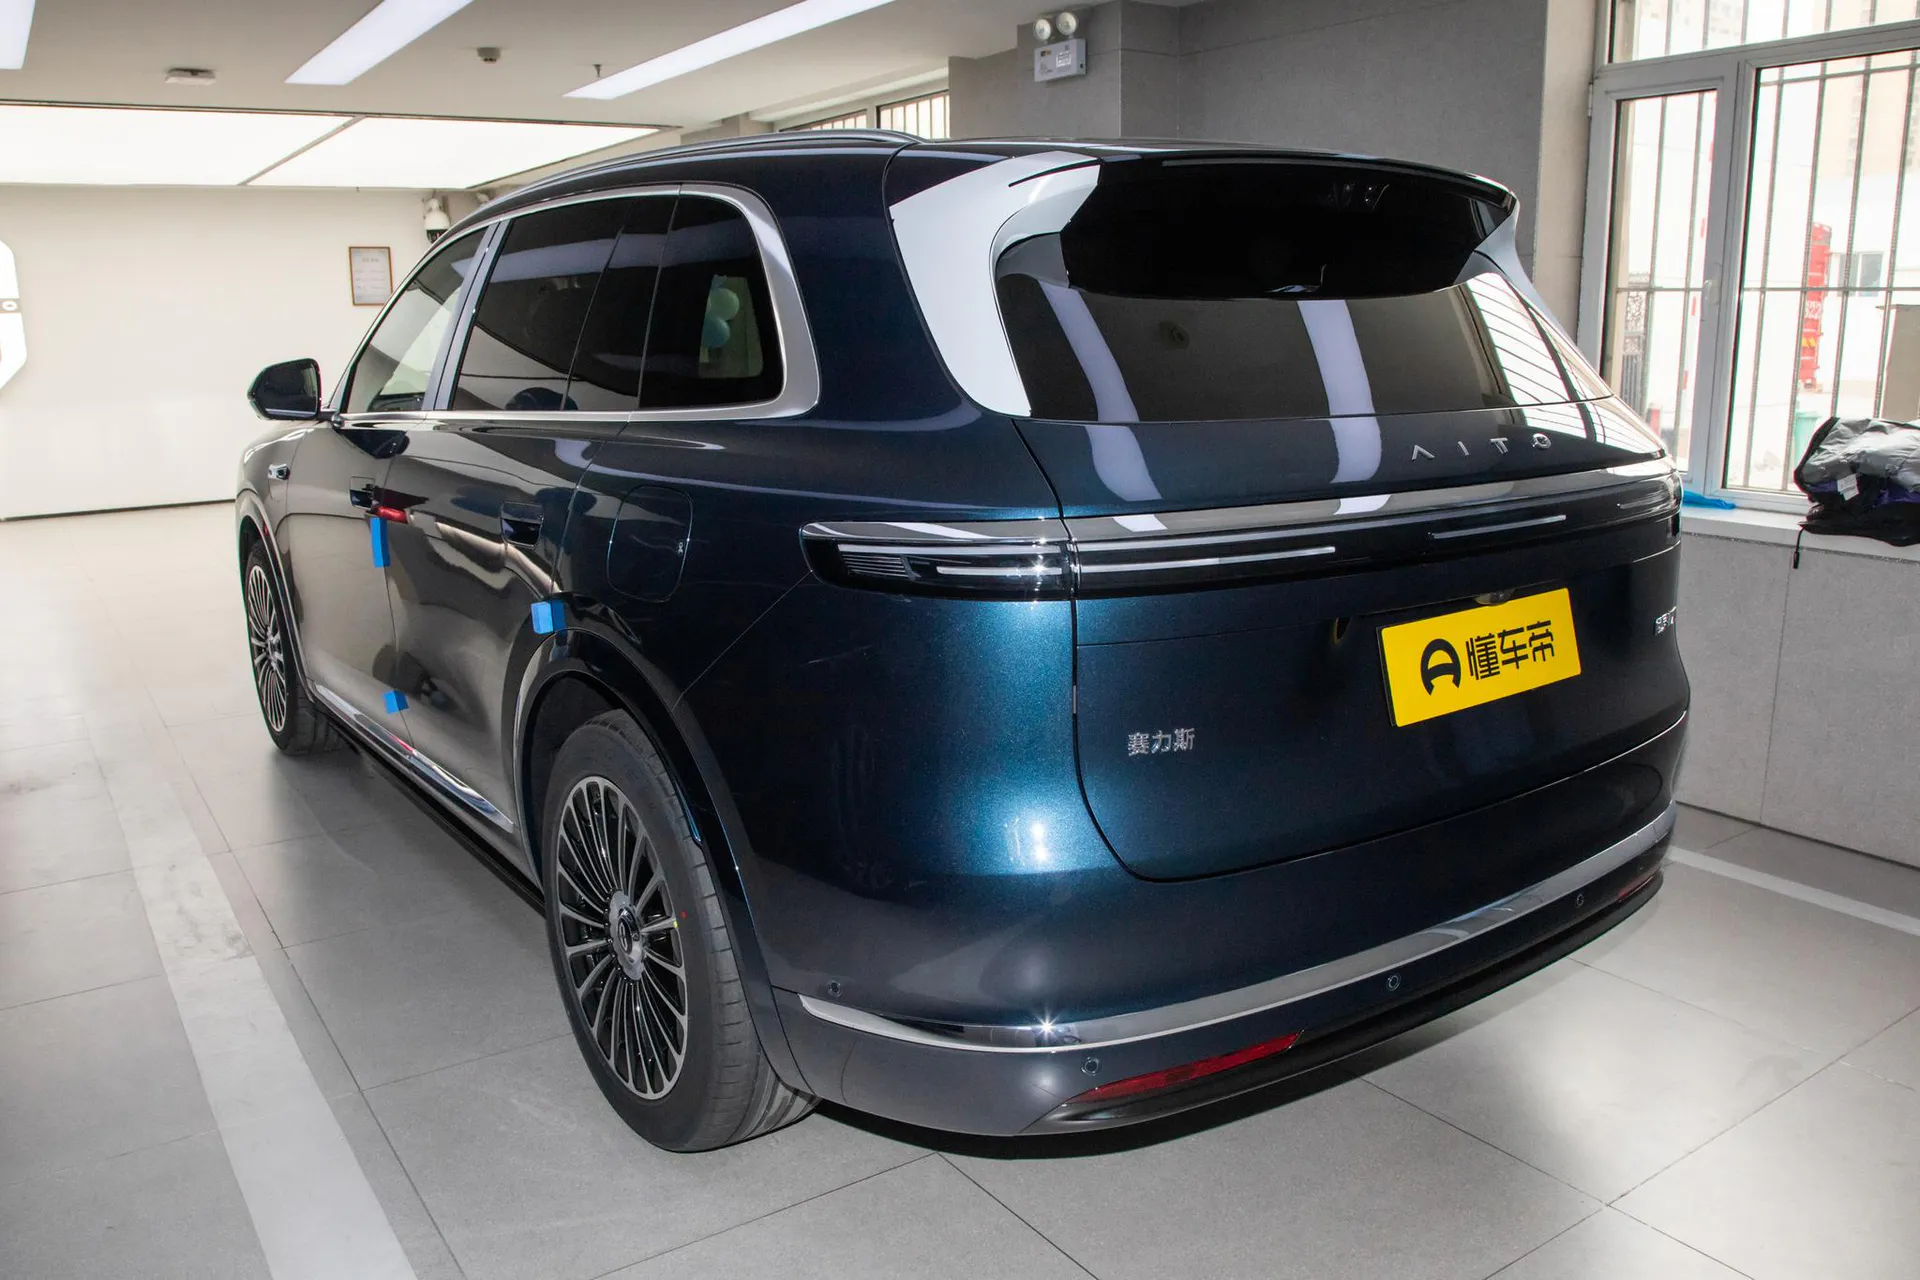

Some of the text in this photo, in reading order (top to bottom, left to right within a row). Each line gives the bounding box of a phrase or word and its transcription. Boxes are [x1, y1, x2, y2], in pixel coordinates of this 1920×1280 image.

[1411, 433, 1552, 461] AITO
[1465, 620, 1555, 681] 懂车帝
[1127, 727, 1196, 757] 赛力斯
